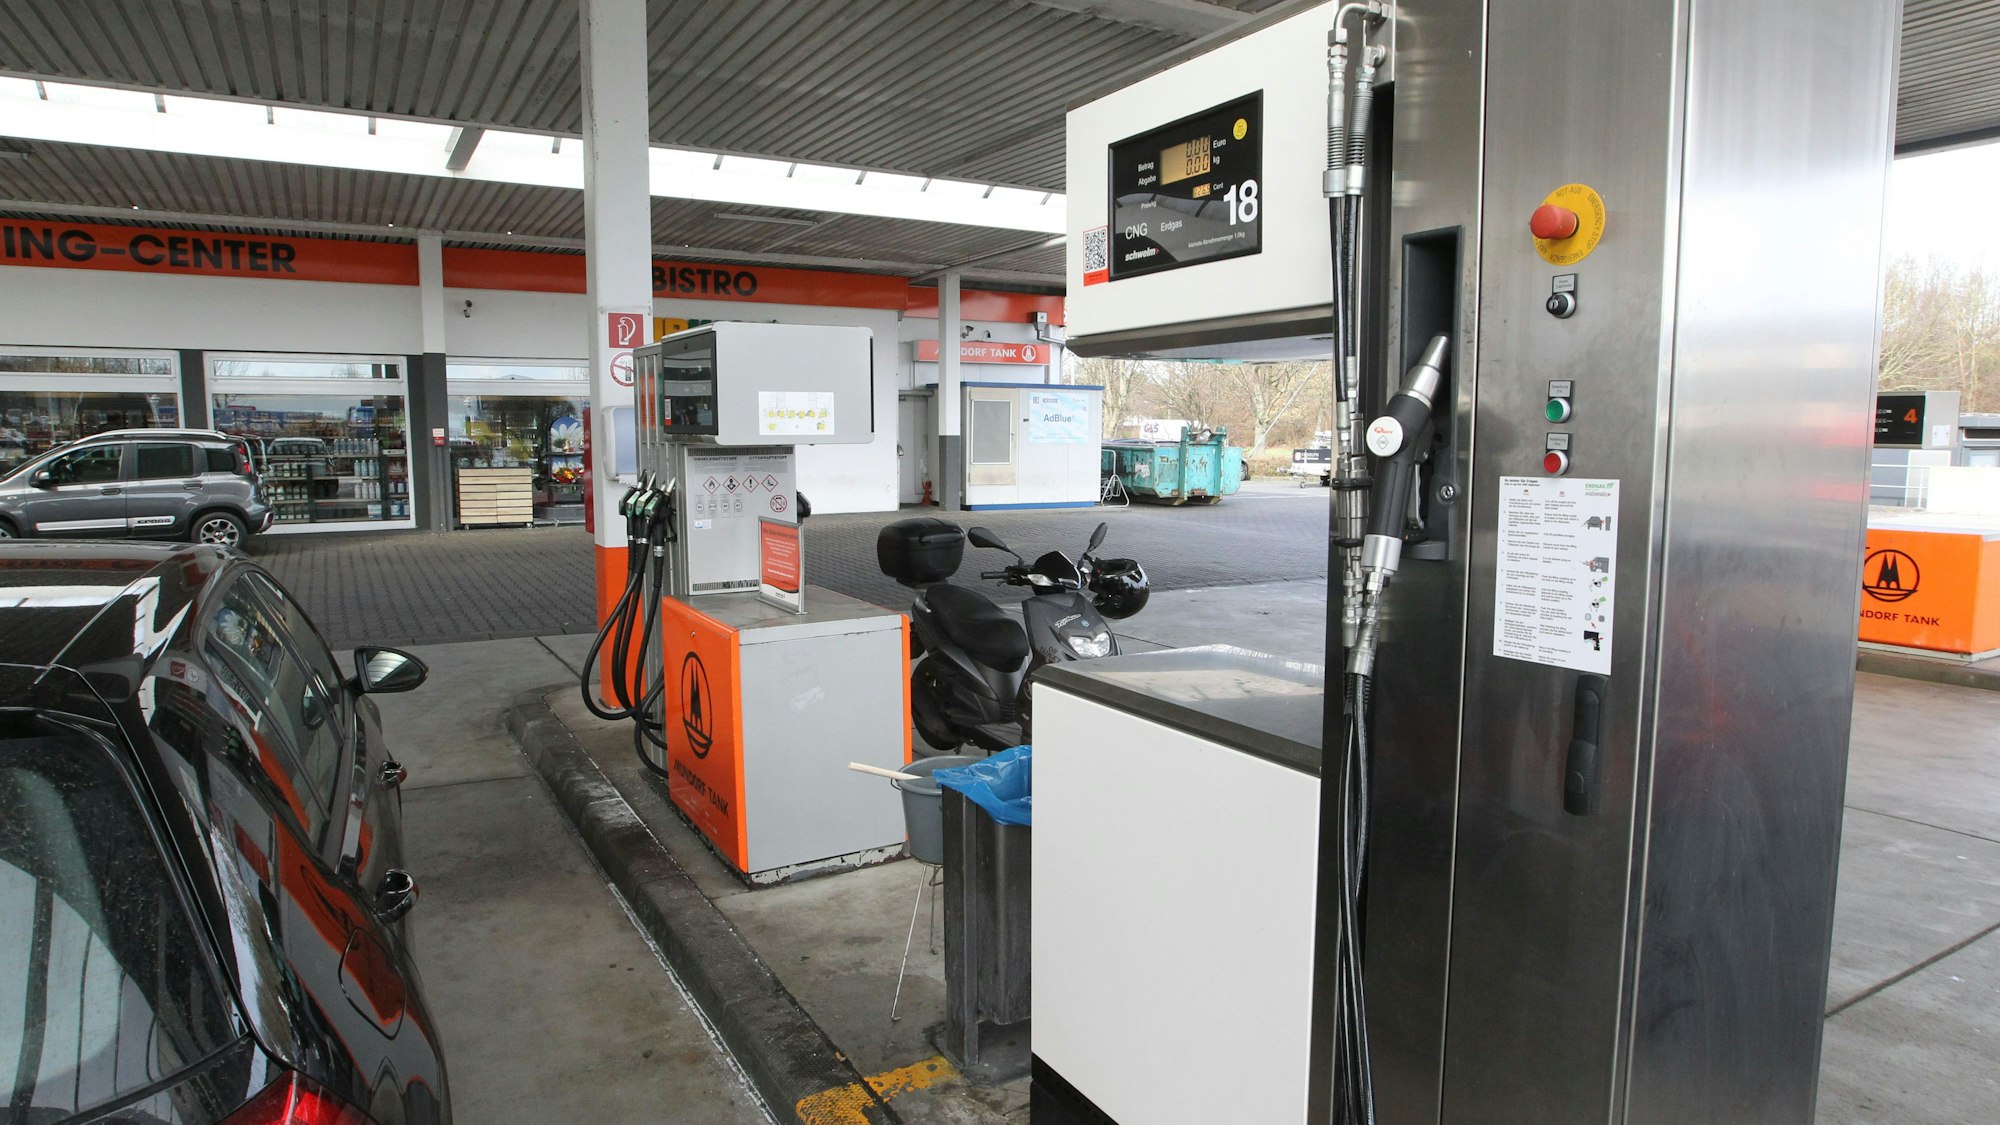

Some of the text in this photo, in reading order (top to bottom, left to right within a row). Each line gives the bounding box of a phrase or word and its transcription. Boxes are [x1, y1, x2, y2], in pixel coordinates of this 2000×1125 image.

[1213, 139, 1227, 149] Euro
[1212, 155, 1221, 165] kg
[1138, 161, 1154, 172] Betrag
[1138, 174, 1156, 186] Abgabe
[1212, 181, 1224, 191] Cent
[1222, 178, 1259, 226] 18
[1125, 220, 1182, 240] CNG Erdgas
[1125, 247, 1156, 261] schwelm
[653, 265, 758, 297] BISTRO
[990, 348, 1017, 358] TANK
[1043, 413, 1072, 423] AdBlue
[1903, 407, 1919, 424] 4
[1903, 614, 1940, 626] TANK
[673, 756, 730, 818] MUNDORF TANK
